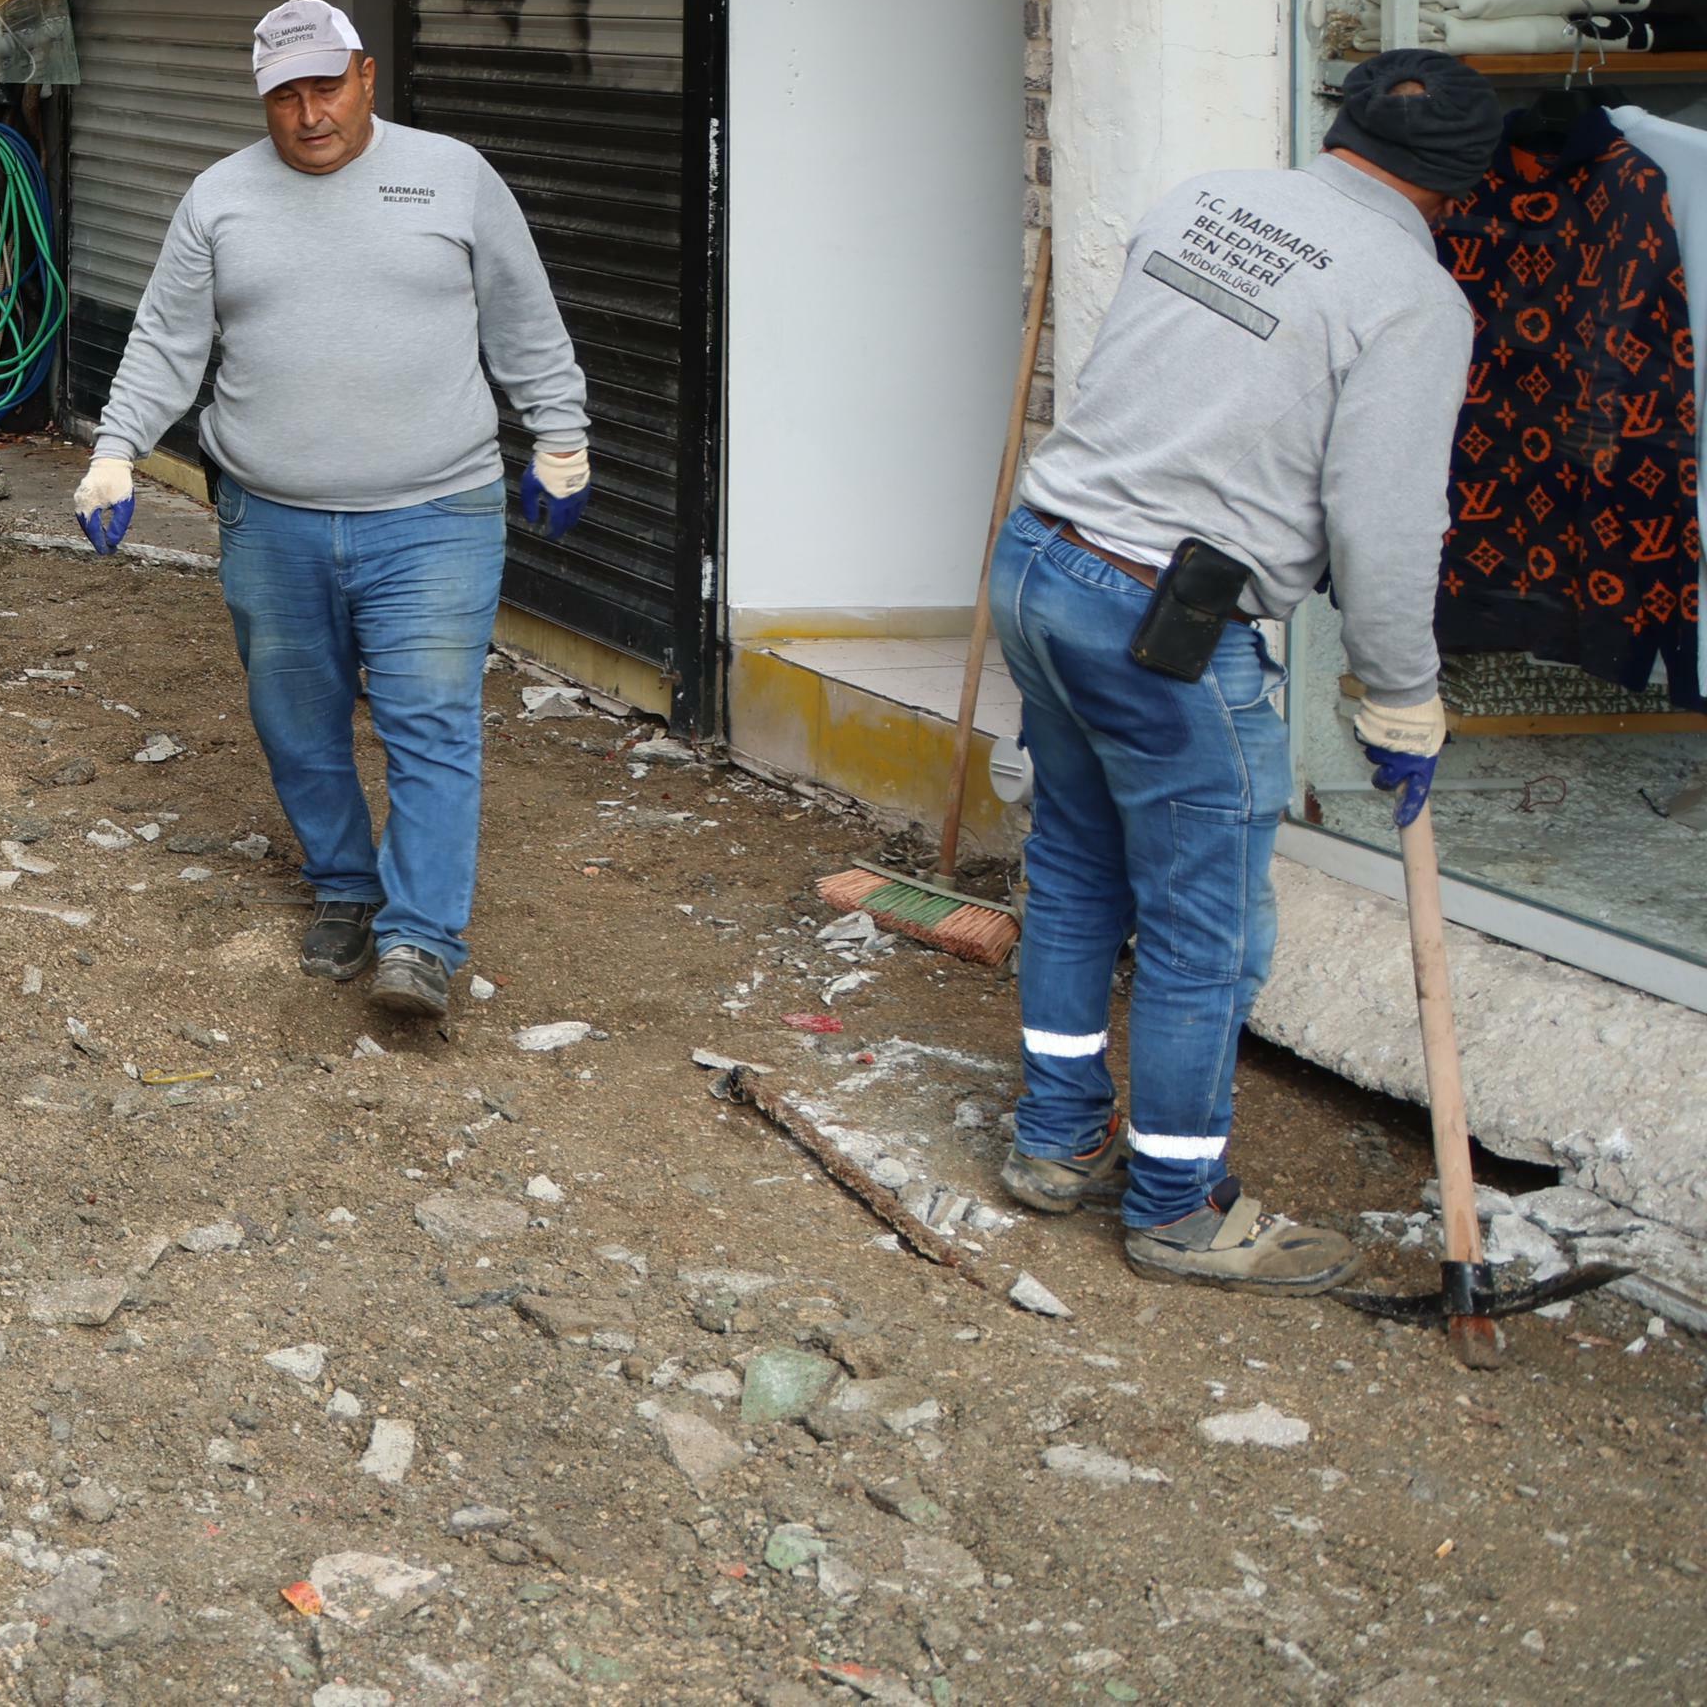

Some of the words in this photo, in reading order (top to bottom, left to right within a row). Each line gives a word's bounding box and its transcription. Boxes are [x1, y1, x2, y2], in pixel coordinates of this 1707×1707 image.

[1181, 229, 1221, 255] FEN
[1222, 247, 1284, 288] İŞLERİ
[1193, 215, 1300, 274] BELEDİYESİ
[1195, 190, 1226, 215] T.C.
[1226, 207, 1334, 271] MARMARİS
[1179, 248, 1261, 298] MÜDÜRLÜĞÜ
